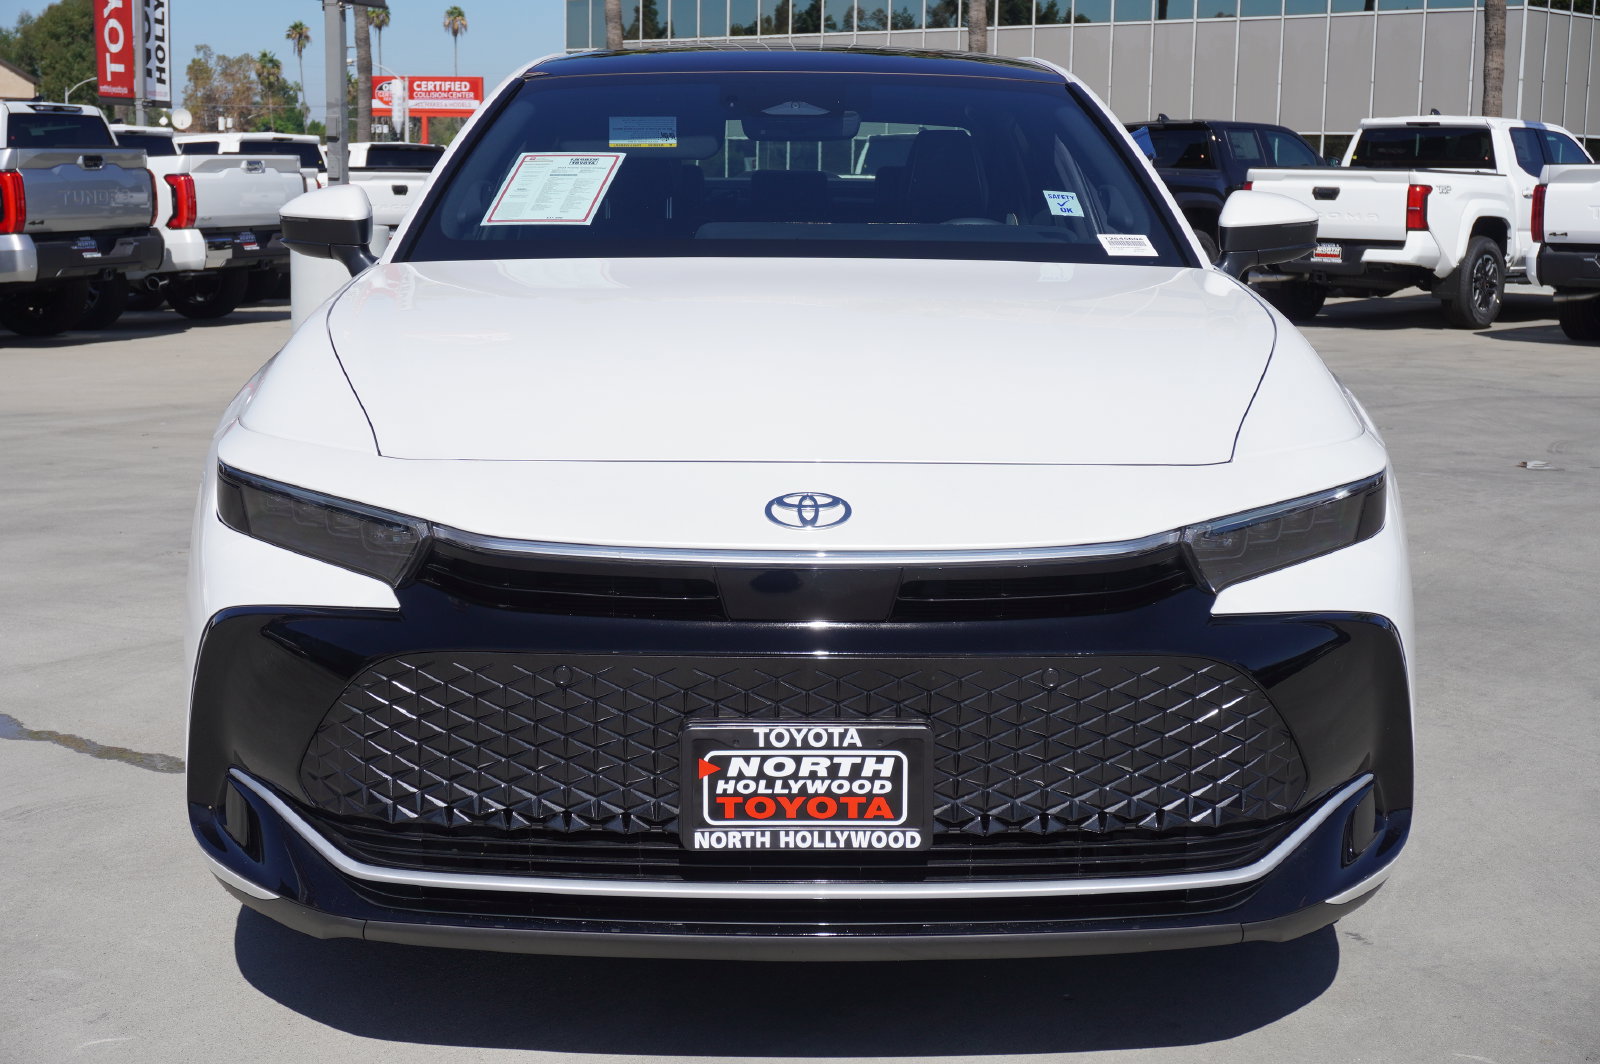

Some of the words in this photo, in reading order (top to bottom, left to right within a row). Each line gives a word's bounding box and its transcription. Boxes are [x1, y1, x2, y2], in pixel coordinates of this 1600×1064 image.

[413, 81, 470, 91] CERTIFIED
[752, 728, 863, 748] TOYOTA
[727, 757, 895, 777] NORTH
[715, 779, 893, 795] HOLLYWOOD
[715, 796, 895, 819] TOYOTA
[694, 831, 771, 849] NORTH
[779, 830, 922, 849] HOLLYWOOD
